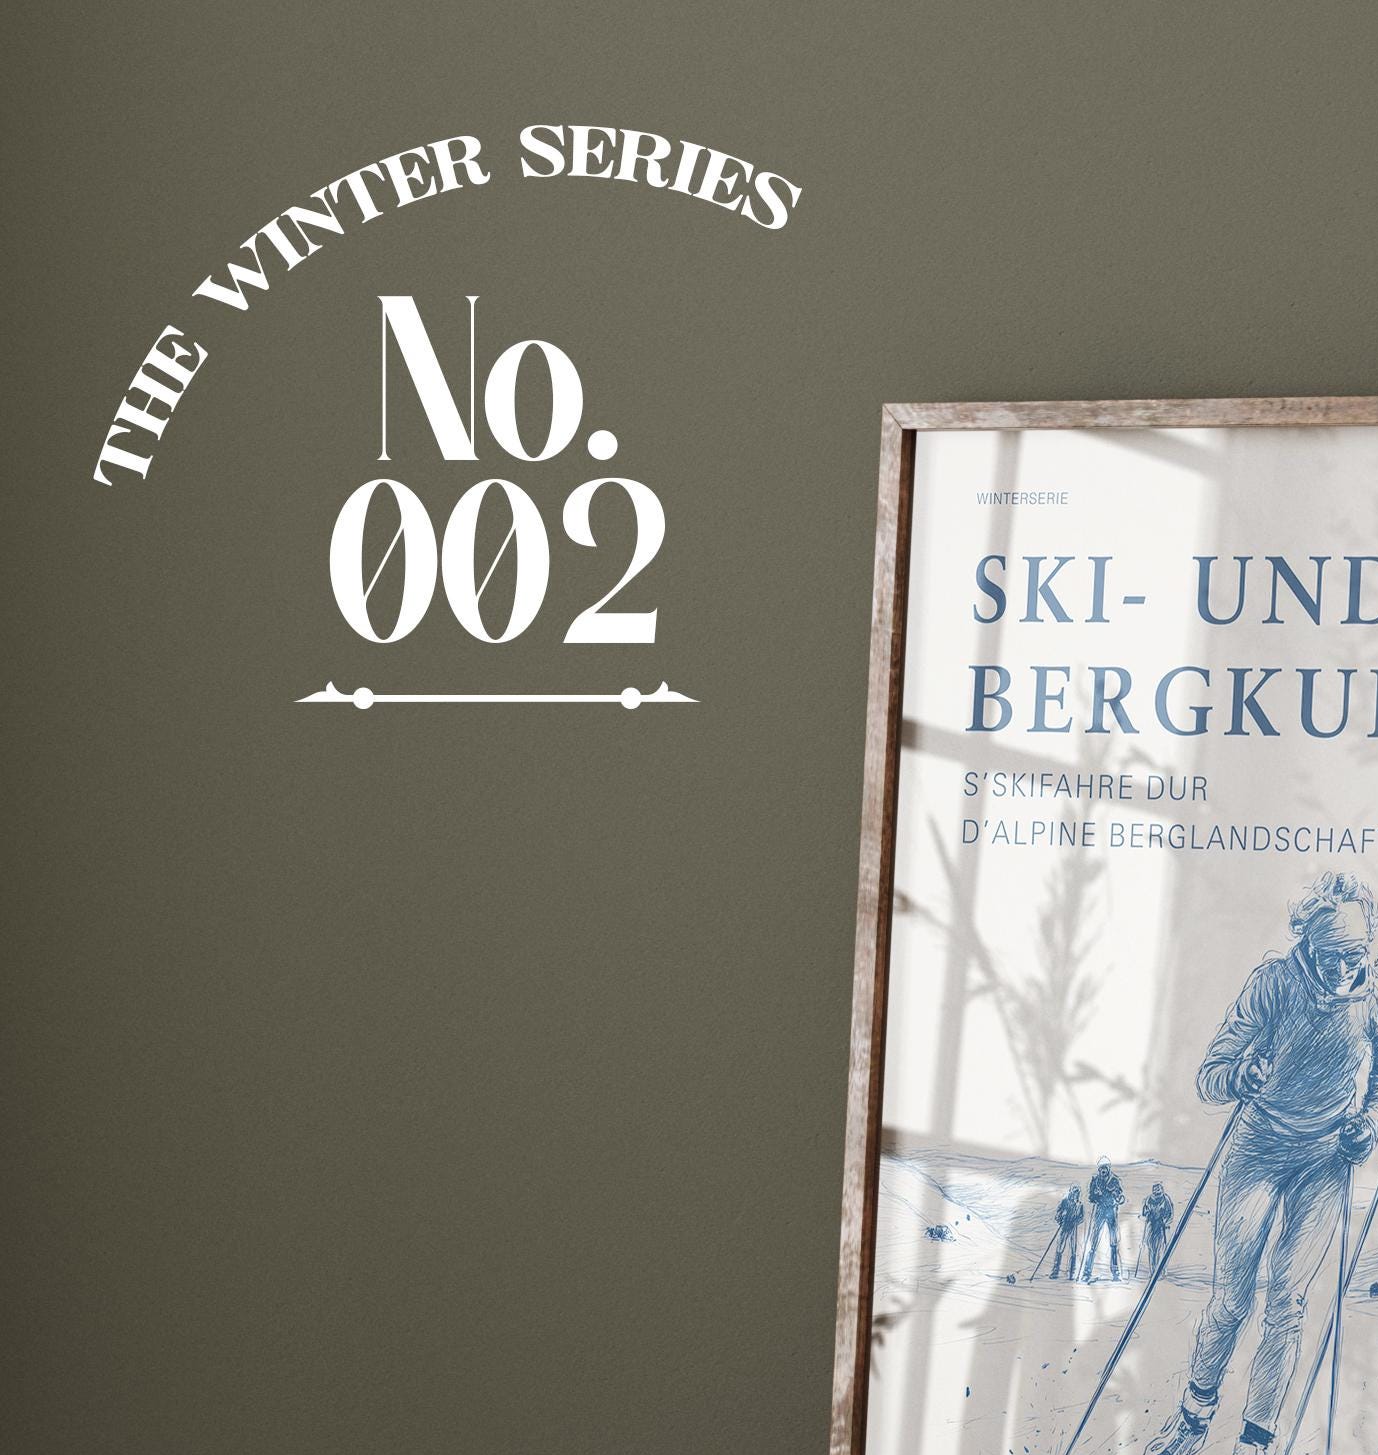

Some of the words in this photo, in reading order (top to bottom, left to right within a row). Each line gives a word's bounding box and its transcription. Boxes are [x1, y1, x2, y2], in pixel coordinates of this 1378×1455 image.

[976, 491, 1069, 505] WINTERSERIE
[972, 554, 1146, 625] SKI-
[963, 771, 1134, 800] S'SKIFAHRE
[1146, 775, 1209, 801] DUR
[961, 819, 1097, 848] D'ALPINE
